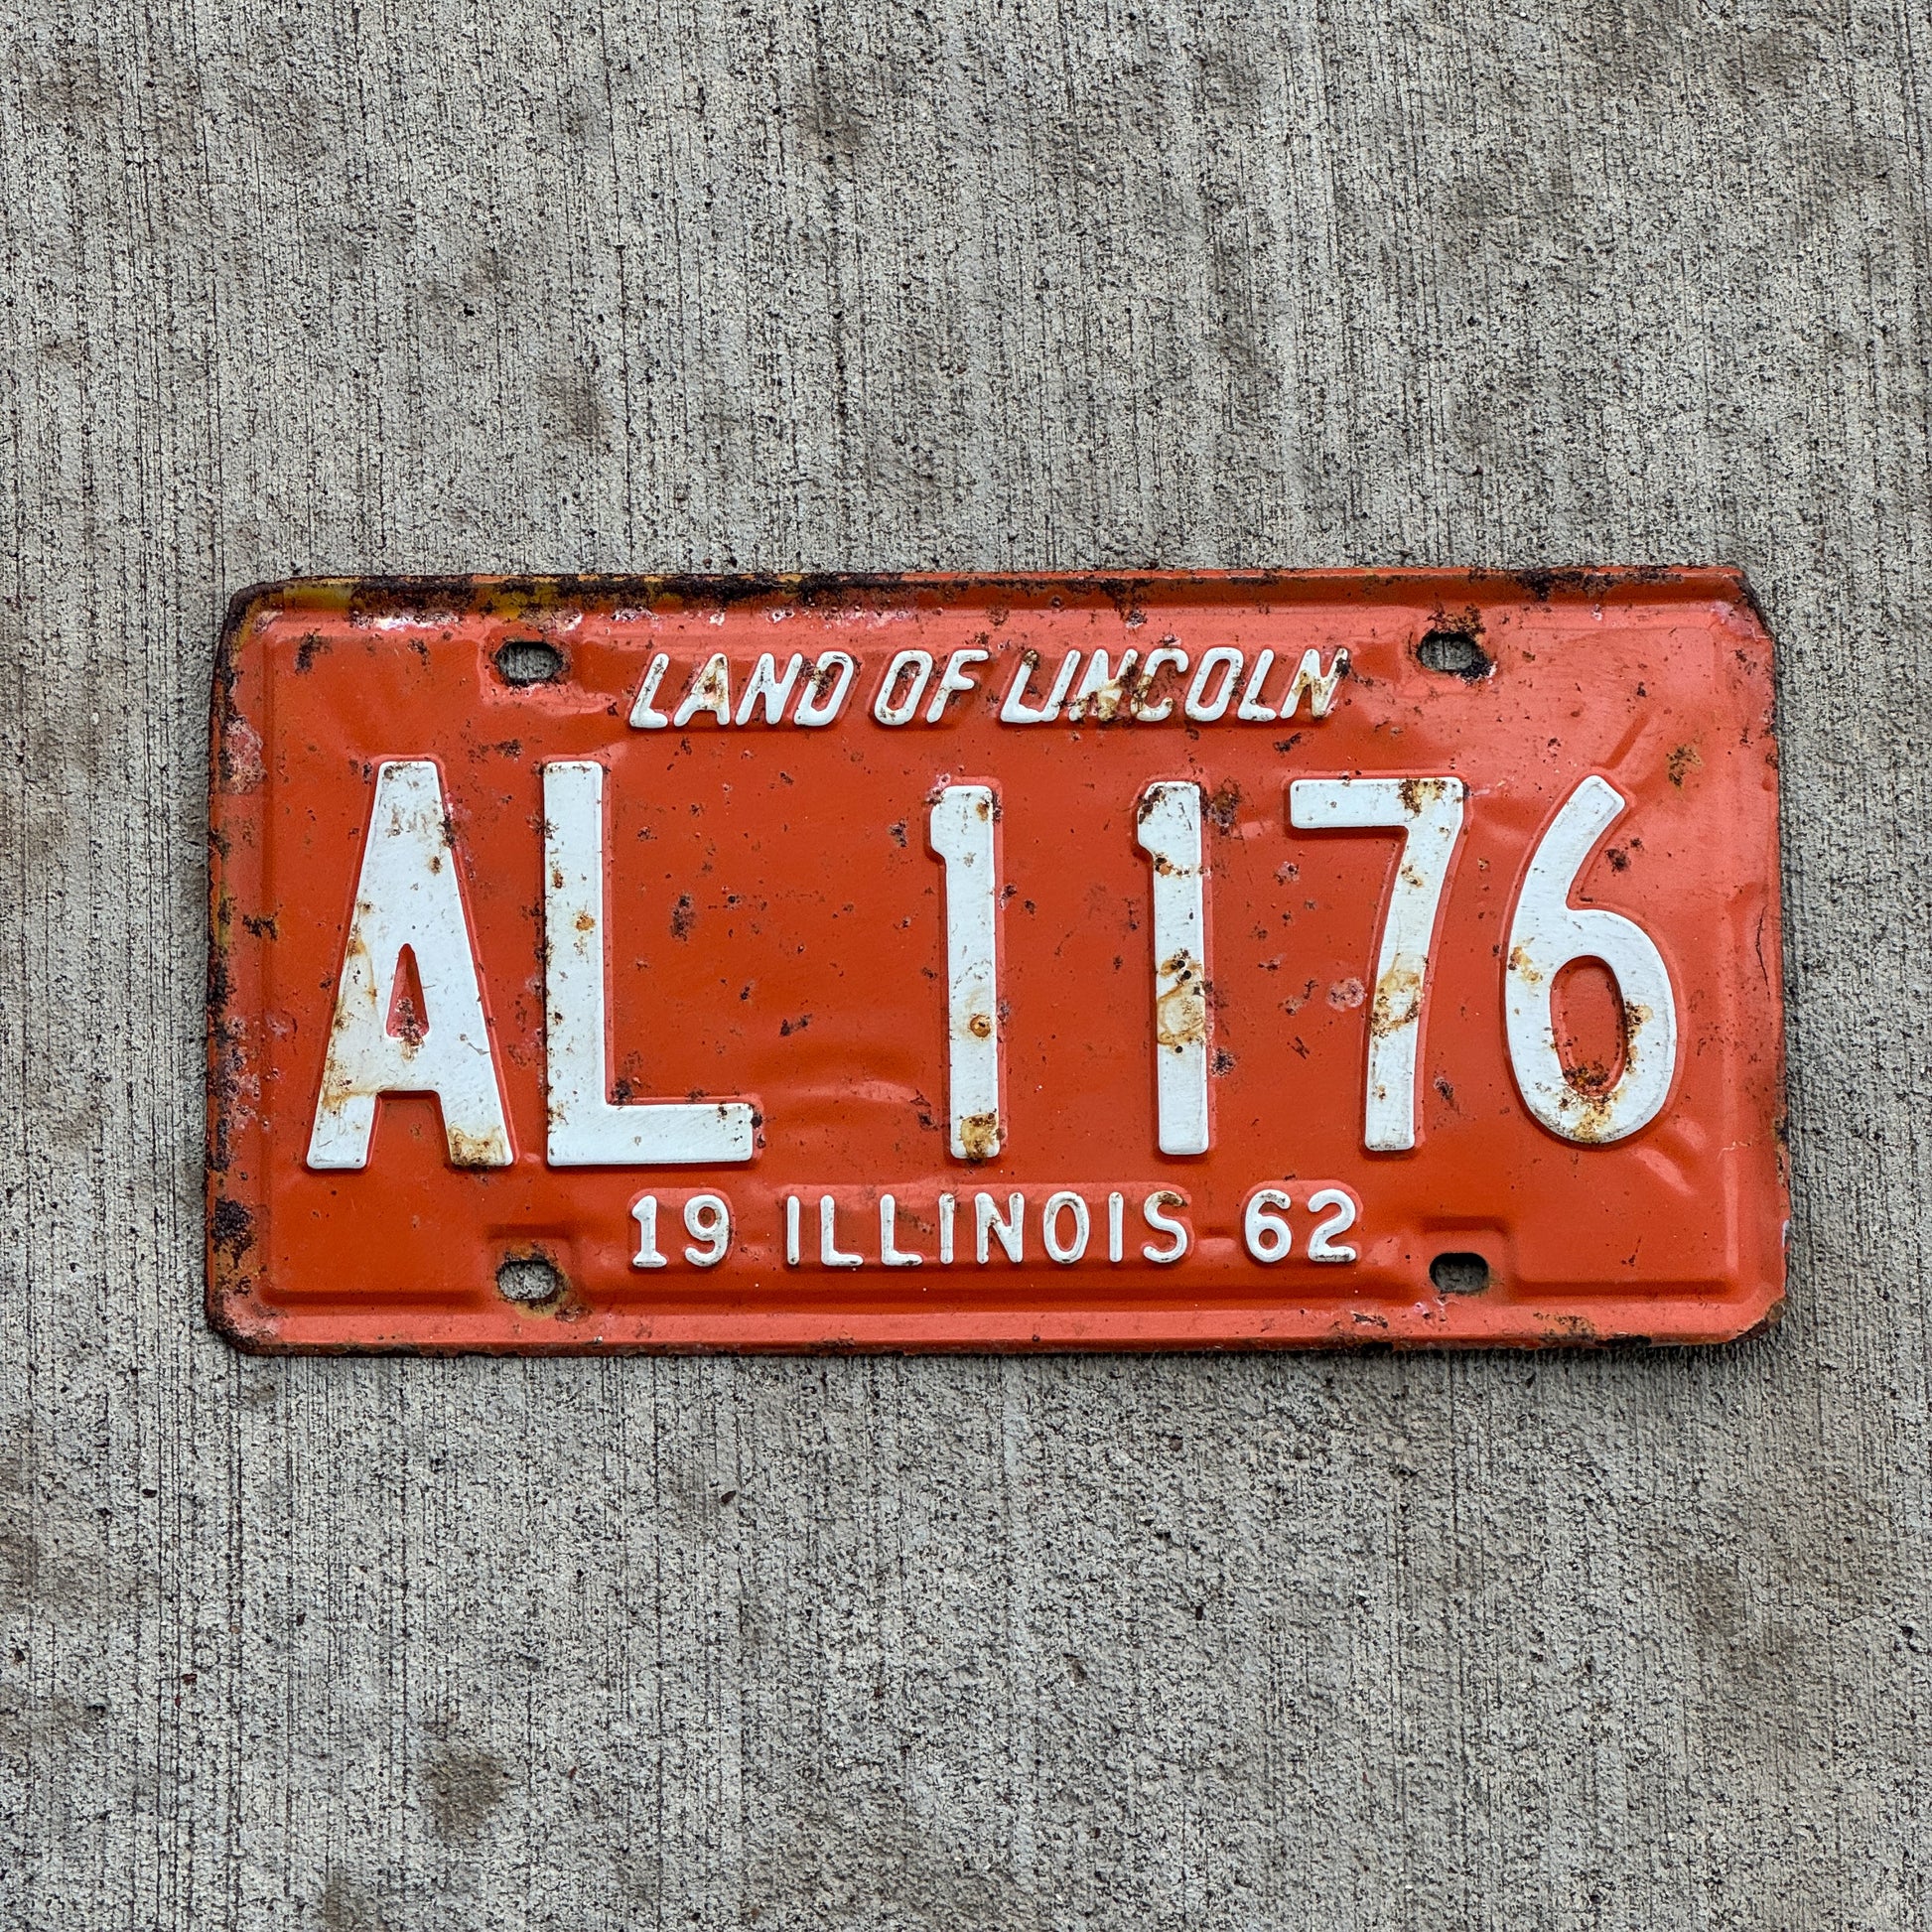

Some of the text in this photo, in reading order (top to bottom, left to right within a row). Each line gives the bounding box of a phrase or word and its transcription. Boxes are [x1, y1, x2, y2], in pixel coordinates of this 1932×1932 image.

[628, 645, 1350, 728] LAND OF LINCOLN
[305, 759, 1679, 1170] AL 1176
[630, 1187, 1358, 1267] 19 ILLINOIS 62
